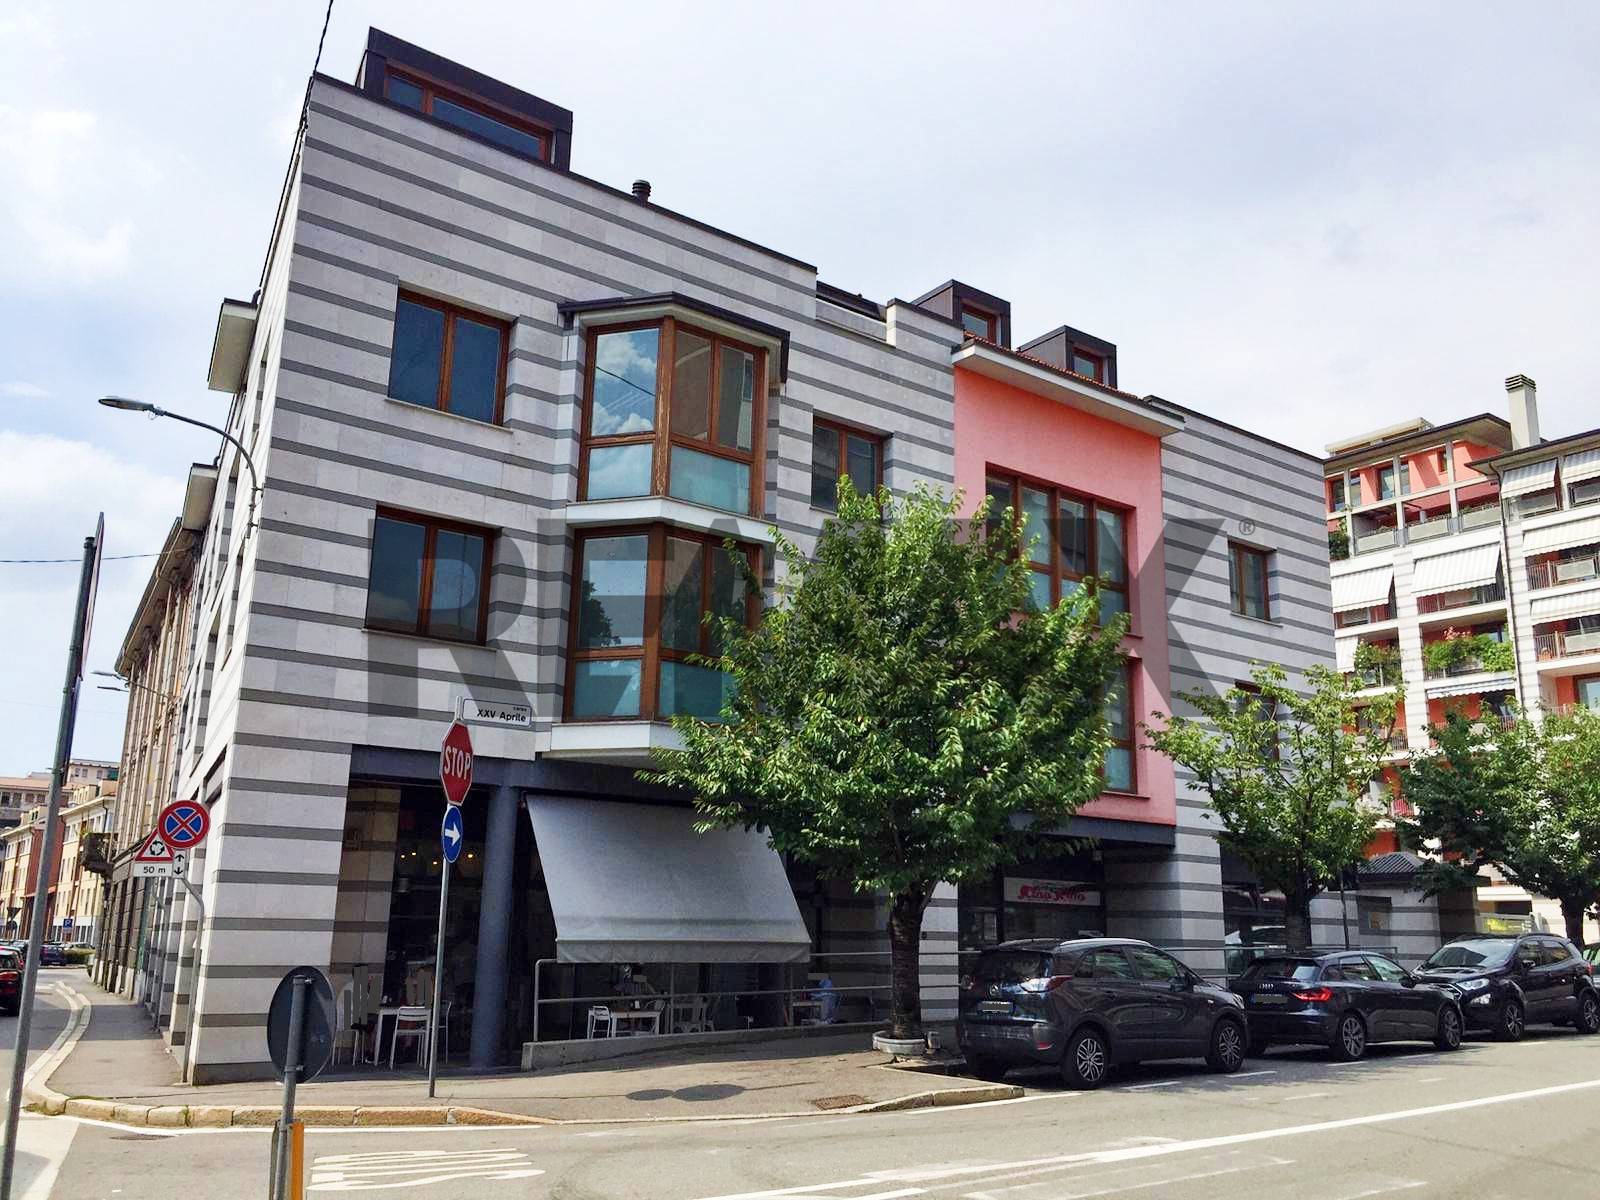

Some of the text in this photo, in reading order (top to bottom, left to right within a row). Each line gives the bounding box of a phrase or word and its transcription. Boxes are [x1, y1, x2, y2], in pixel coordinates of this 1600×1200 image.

[477, 709, 526, 722] XXV Aprile
[444, 745, 471, 780] STOP
[143, 866, 155, 874] 50
